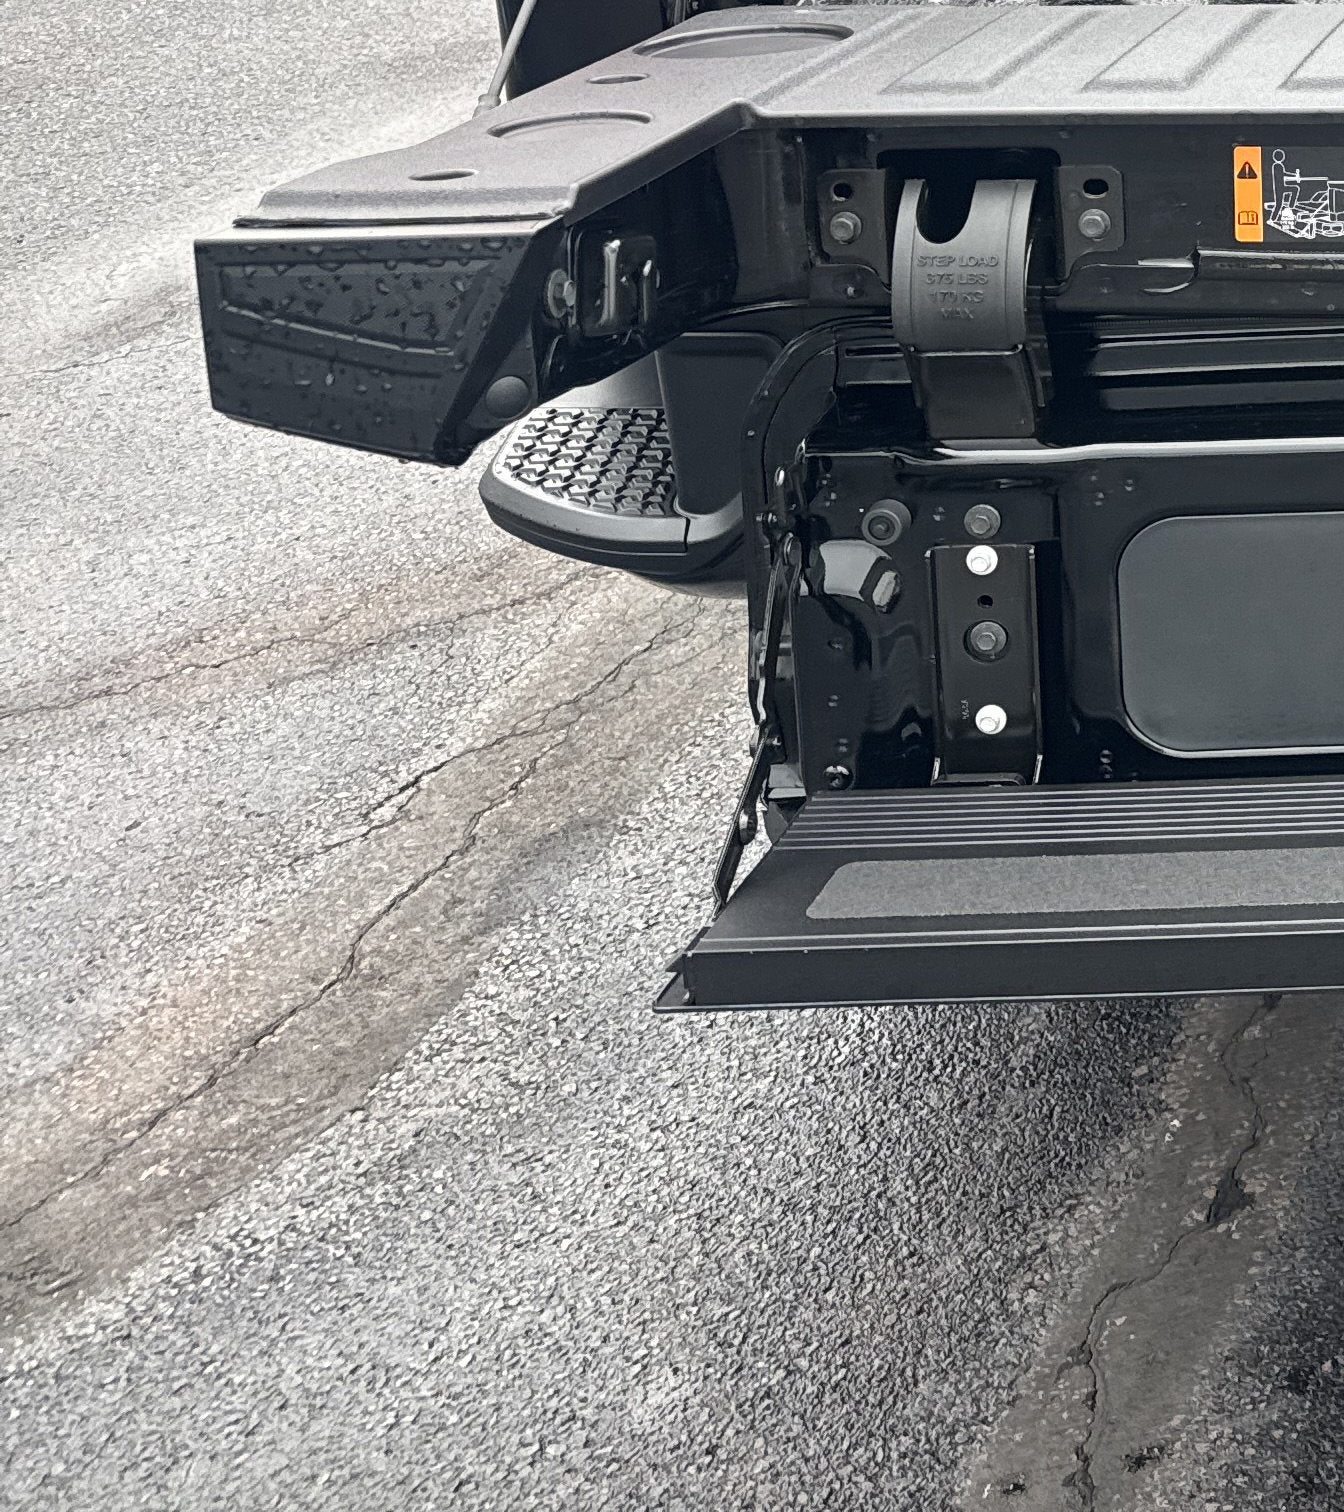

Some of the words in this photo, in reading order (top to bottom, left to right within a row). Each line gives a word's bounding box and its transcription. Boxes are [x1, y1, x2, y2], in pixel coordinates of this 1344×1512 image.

[917, 255, 956, 267] STEP
[959, 255, 999, 267] LOAD
[958, 273, 989, 285] LBS
